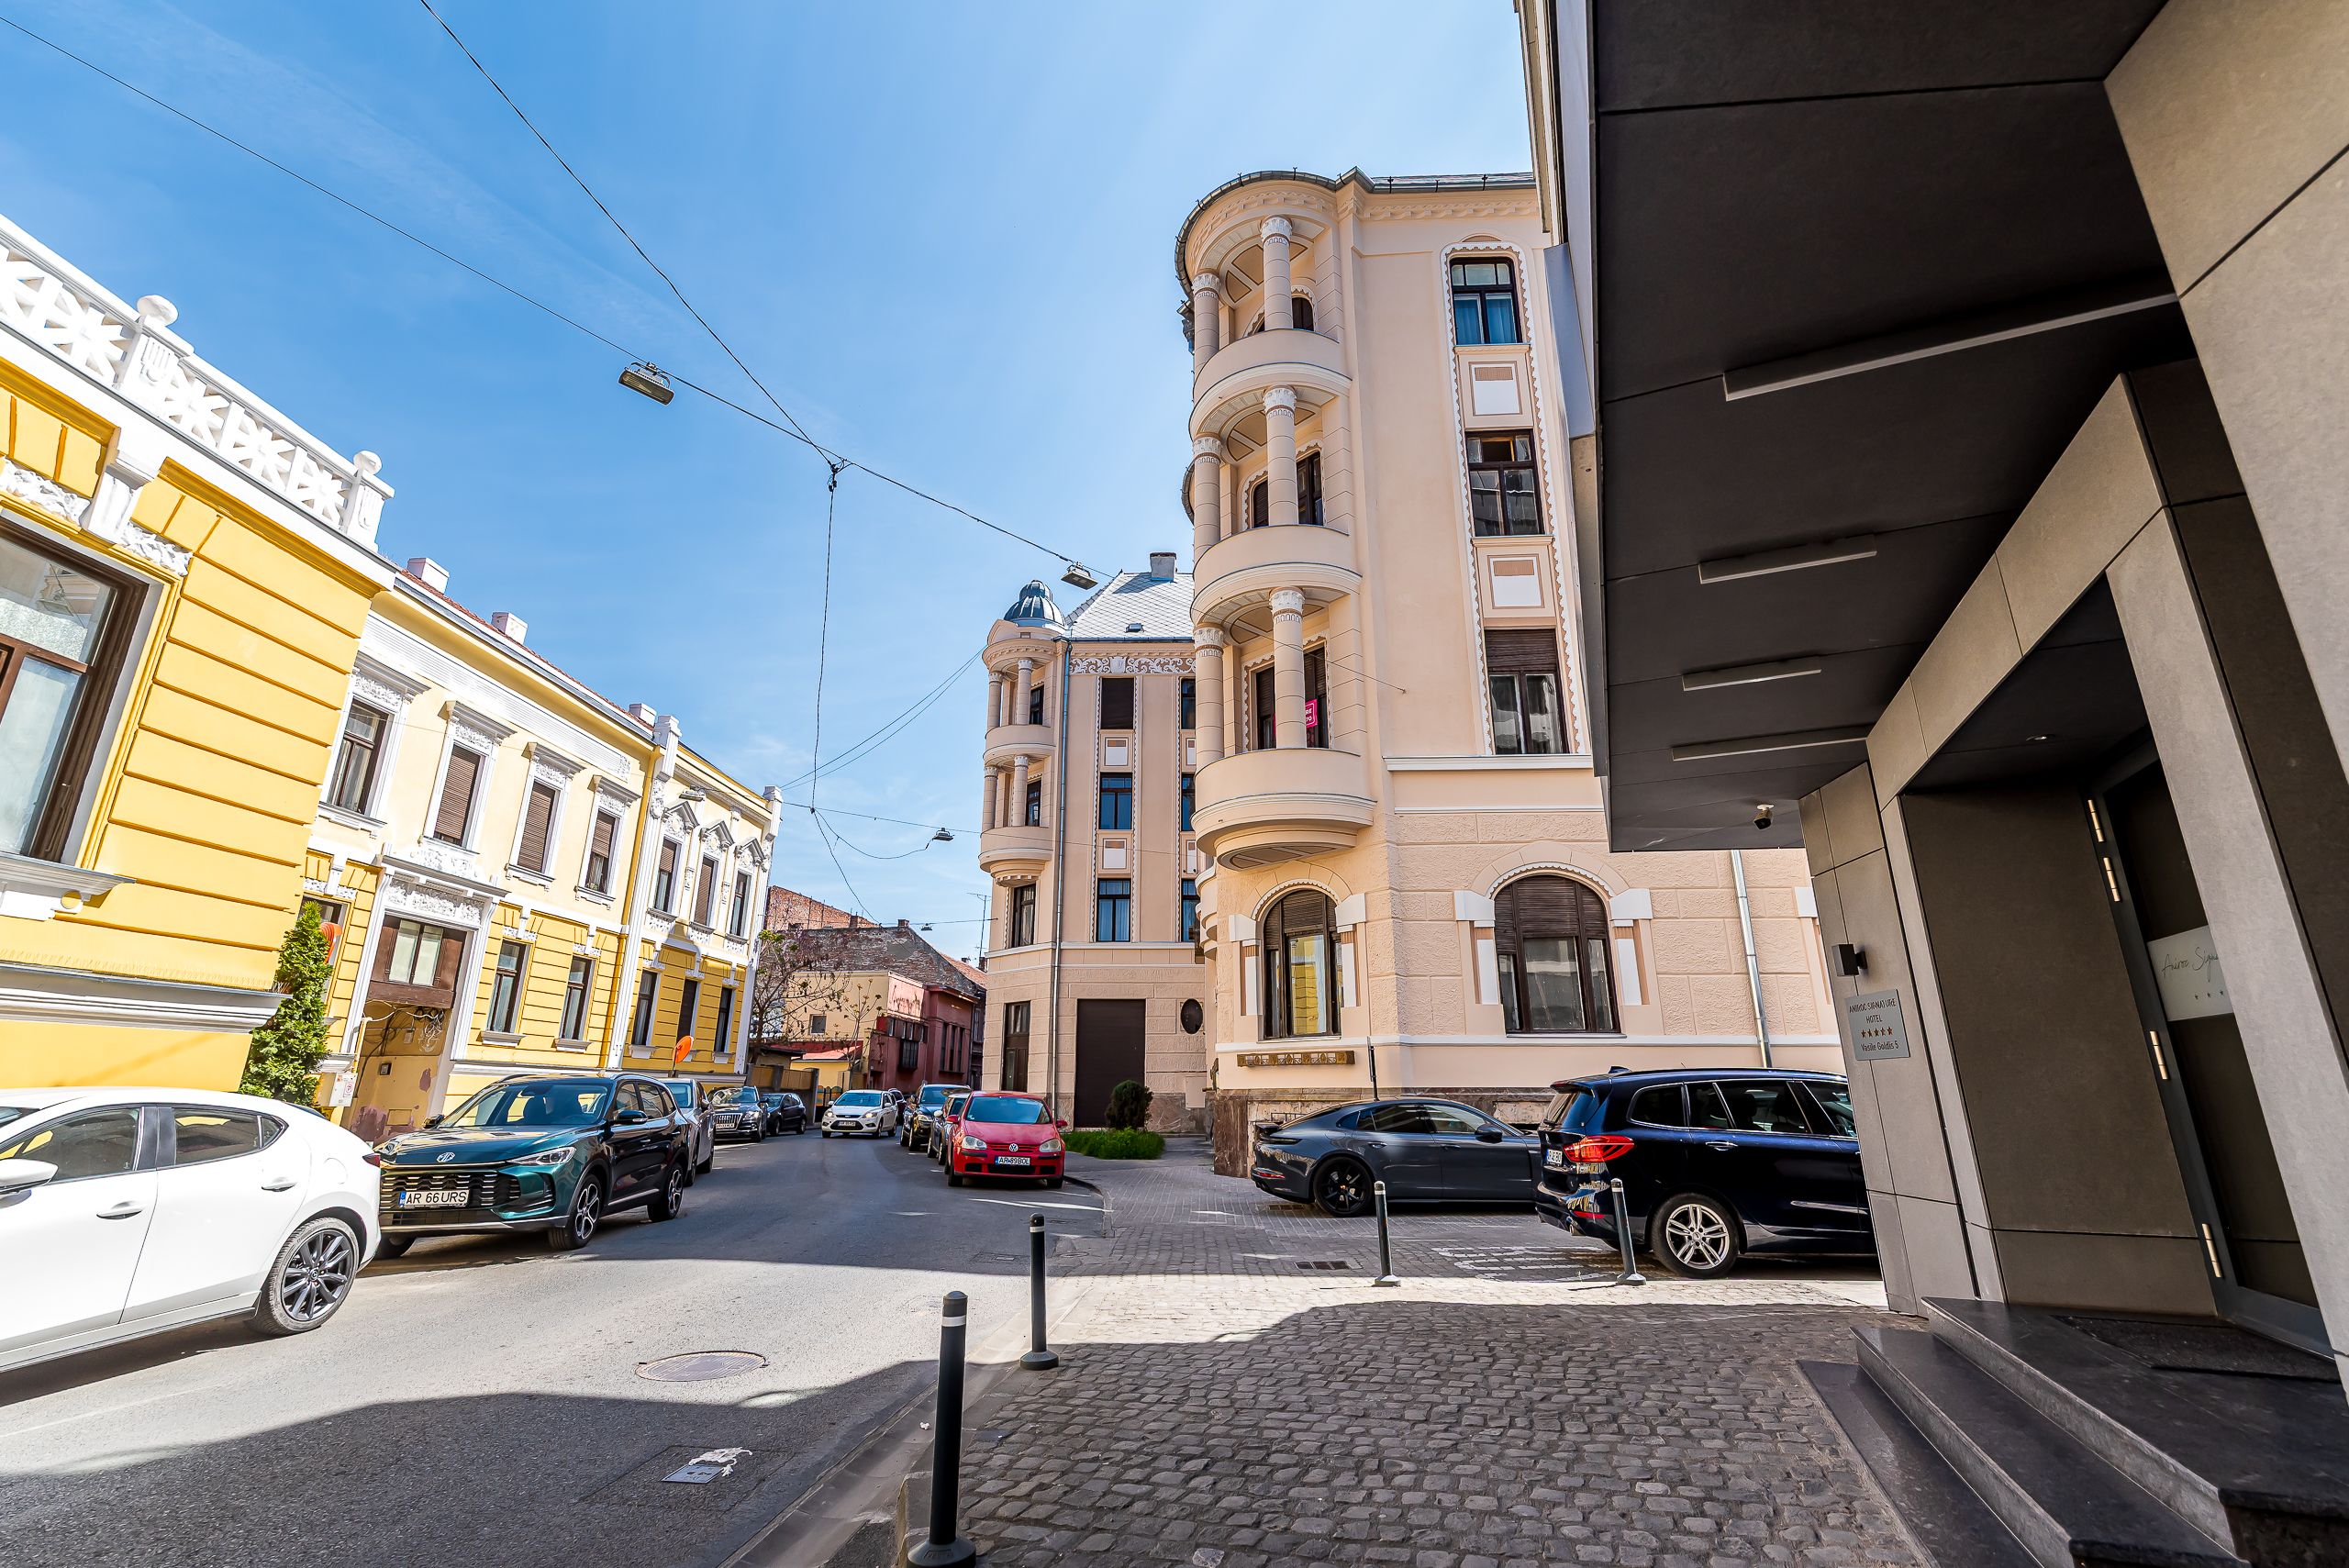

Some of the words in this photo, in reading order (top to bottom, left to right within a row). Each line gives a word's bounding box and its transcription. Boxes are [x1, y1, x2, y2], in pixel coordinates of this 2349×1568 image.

[1865, 1015, 1883, 1023] HOTEL
[1861, 1042, 1876, 1051] Vasile
[1895, 1040, 1899, 1049] 5
[406, 1193, 422, 1204] AR
